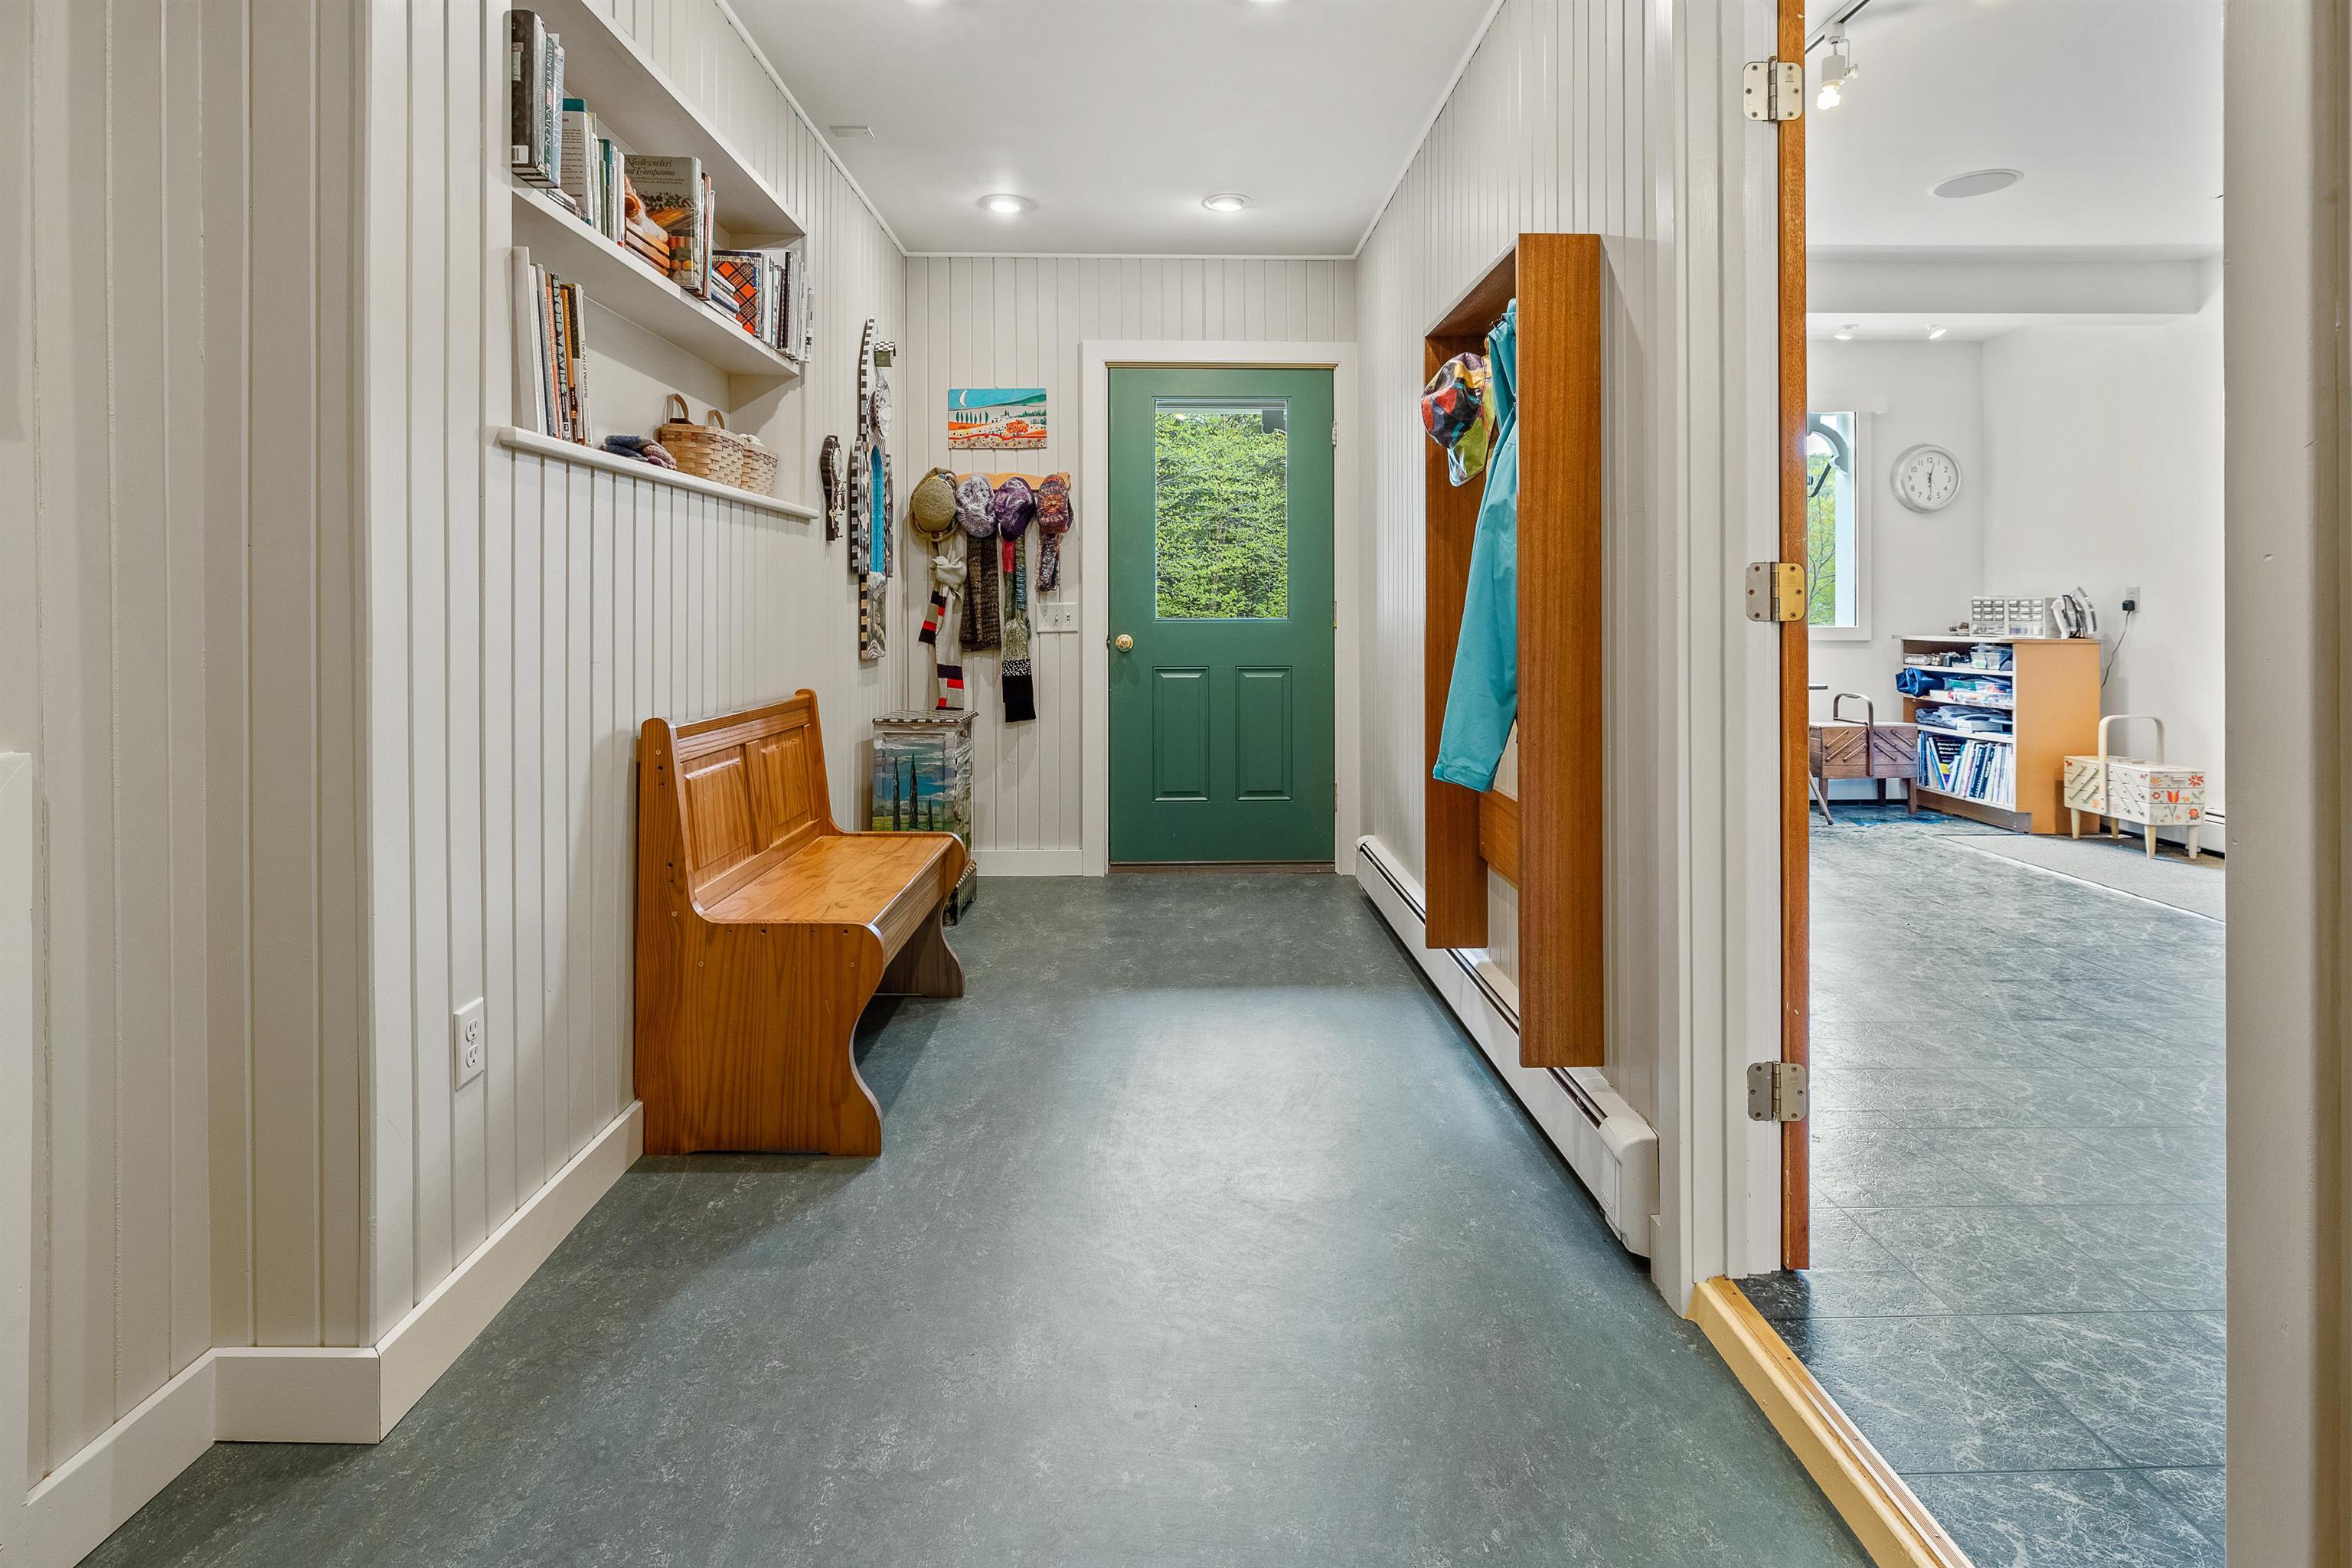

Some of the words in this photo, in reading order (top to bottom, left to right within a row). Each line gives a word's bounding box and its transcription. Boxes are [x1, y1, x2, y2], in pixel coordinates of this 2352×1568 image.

[553, 62, 562, 148] PERENNIALS
[637, 168, 675, 177] Companion
[553, 278, 563, 332] BEYOND
[557, 335, 567, 394] WEAVING
